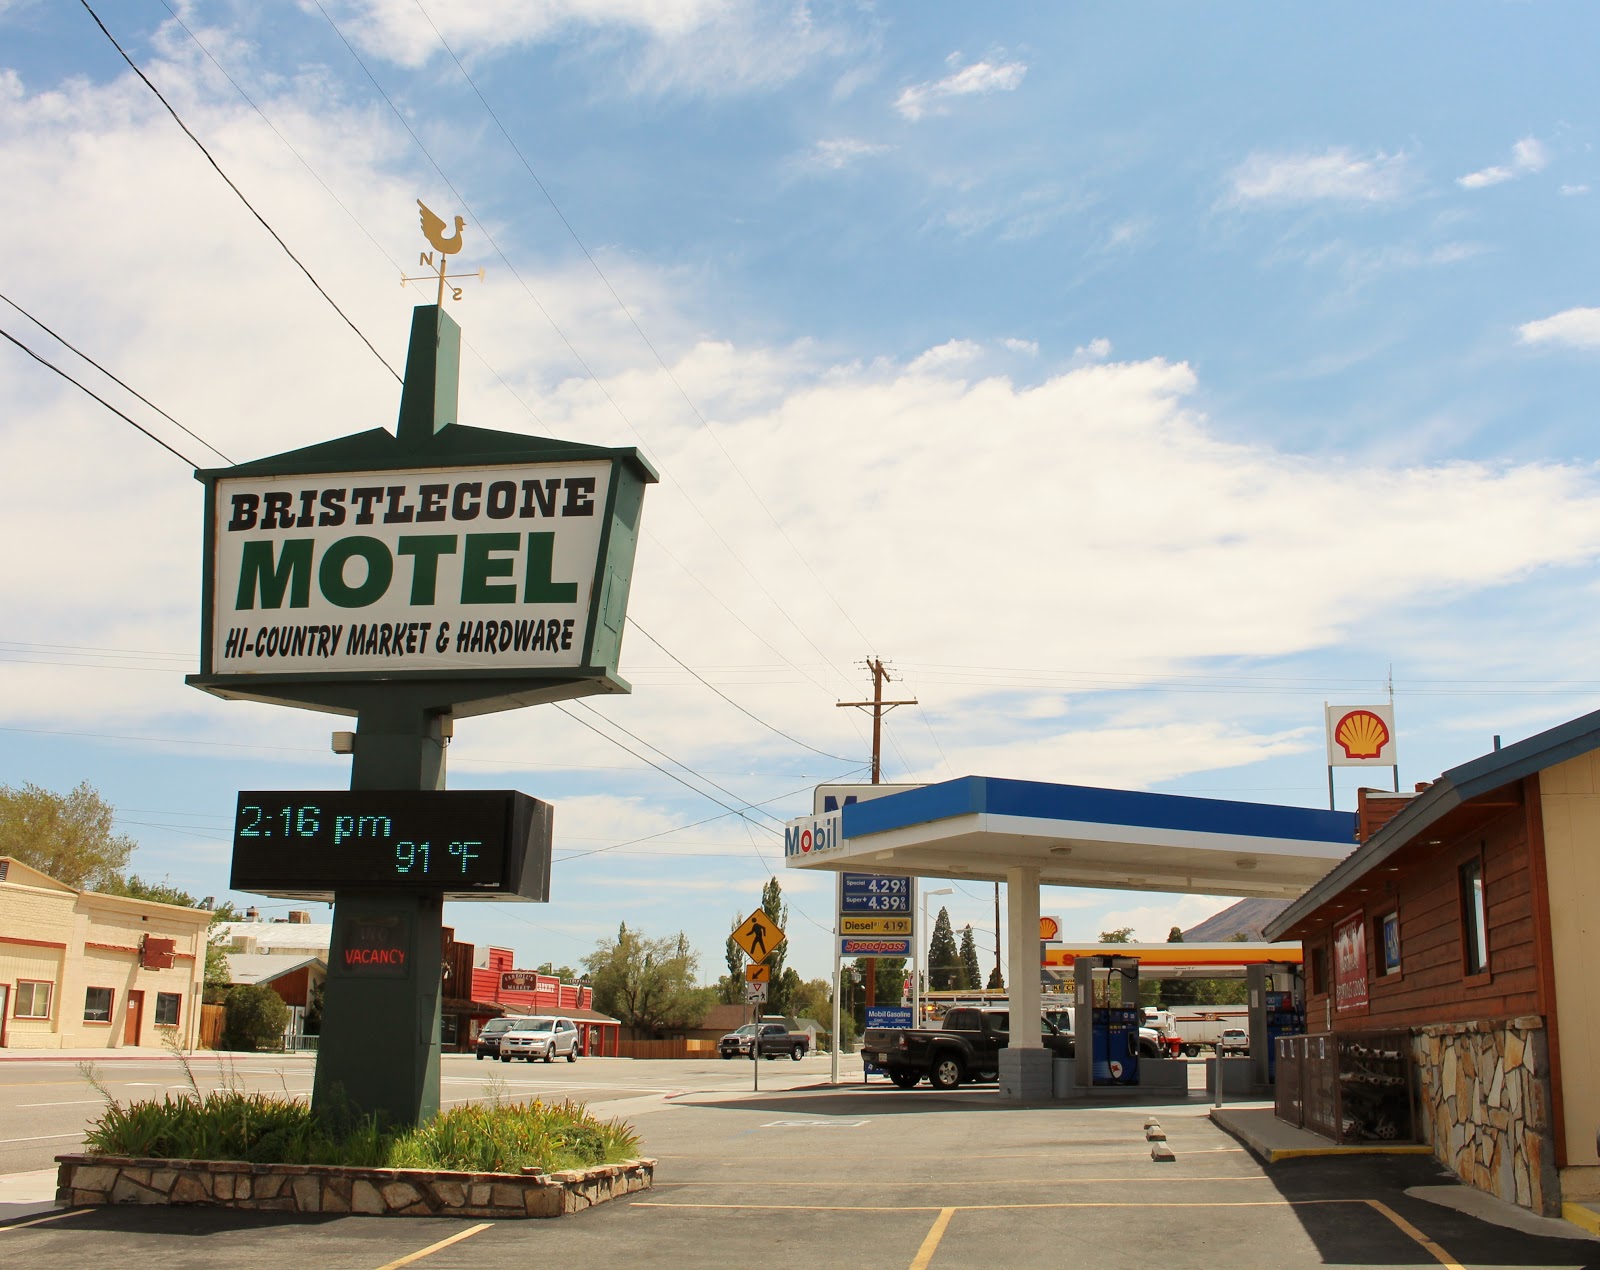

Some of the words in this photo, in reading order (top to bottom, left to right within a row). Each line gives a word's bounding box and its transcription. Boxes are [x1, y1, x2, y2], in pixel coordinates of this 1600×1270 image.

[228, 477, 596, 532] BRISTLECONE
[235, 531, 578, 611] MOTEL
[224, 623, 343, 659] HI-COUNTRY
[346, 621, 432, 656] MARKET
[435, 621, 450, 654] &
[456, 618, 575, 655] HARDWARE
[240, 806, 320, 837] 2:16
[335, 816, 391, 844] pm
[784, 816, 837, 857] Mobil
[396, 842, 429, 873] 91
[868, 880, 900, 893] 4.29
[868, 896, 900, 910] 4.39
[845, 921, 874, 930] Diesel
[345, 949, 405, 964] VACANCY
[845, 940, 906, 952] Speedpass
[886, 1010, 911, 1018] Gasoline
